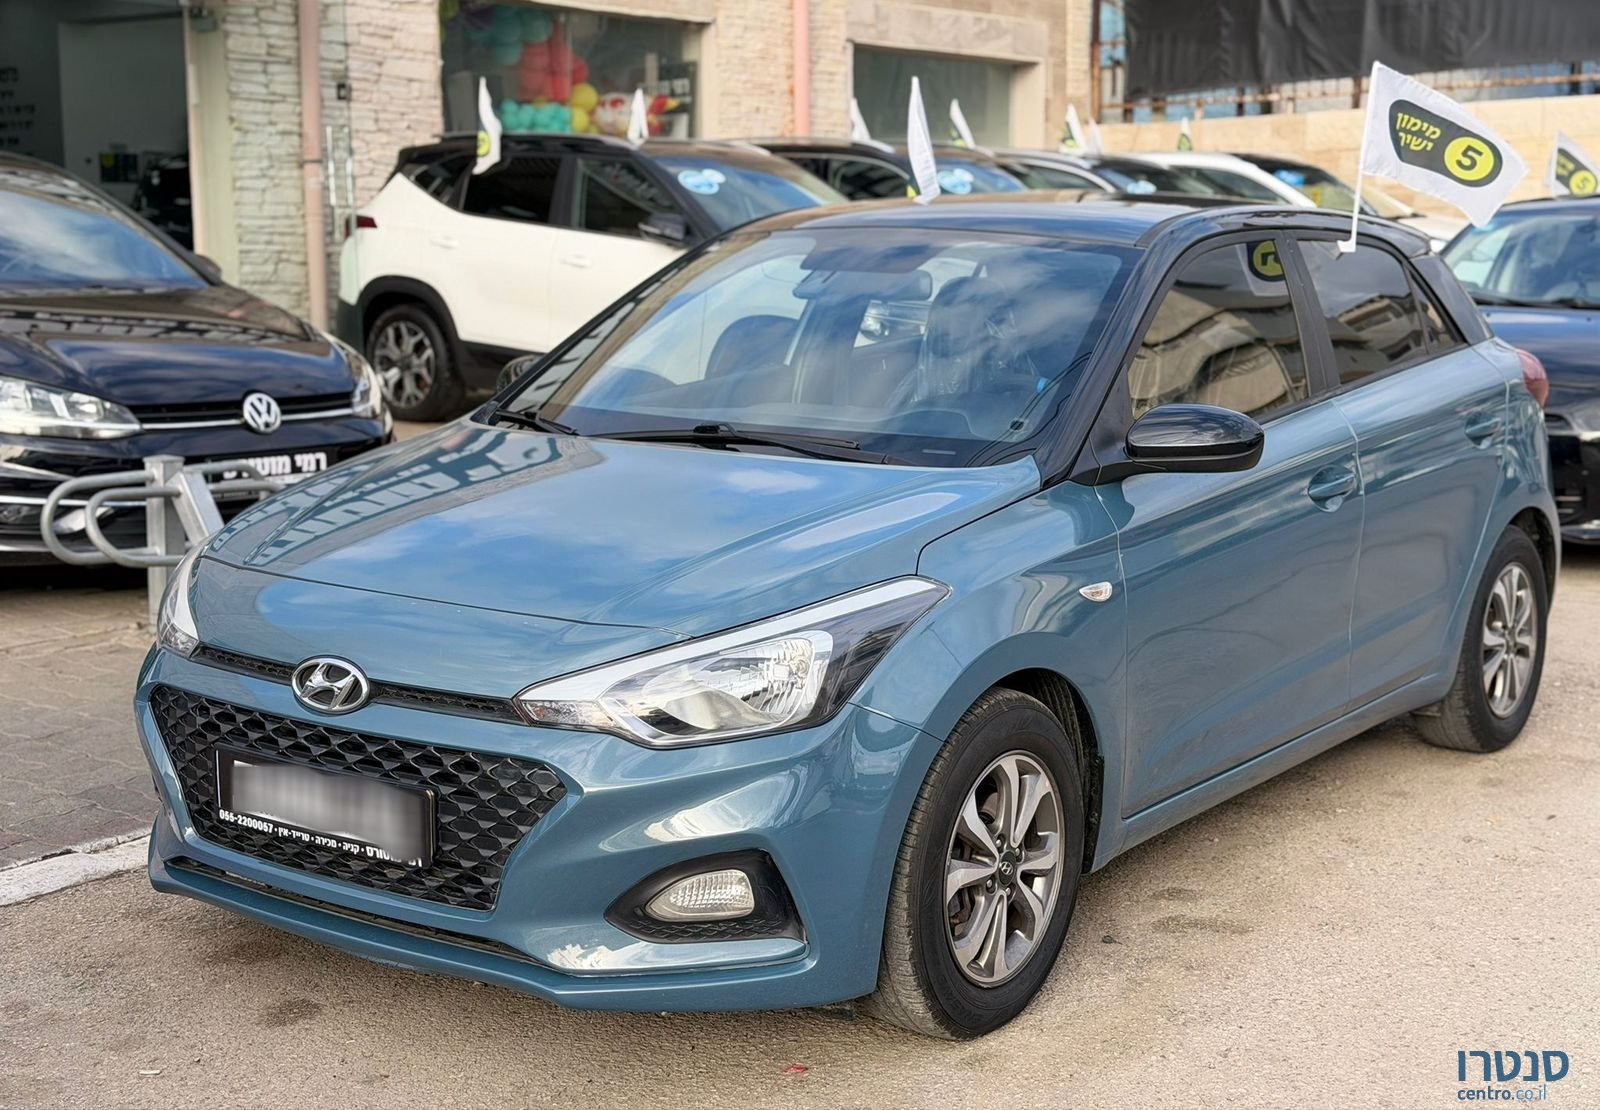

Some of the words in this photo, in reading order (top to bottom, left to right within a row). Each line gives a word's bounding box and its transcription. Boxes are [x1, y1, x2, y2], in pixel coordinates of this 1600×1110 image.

[1396, 112, 1442, 140] מימון
[1398, 131, 1435, 152] ישיר
[1455, 144, 1484, 172] 5
[294, 451, 328, 473] רמי
[219, 808, 274, 834] 055-2200057
[278, 826, 311, 842] טרייד-אין
[314, 835, 338, 849] מכירה
[342, 841, 360, 855] קניה
